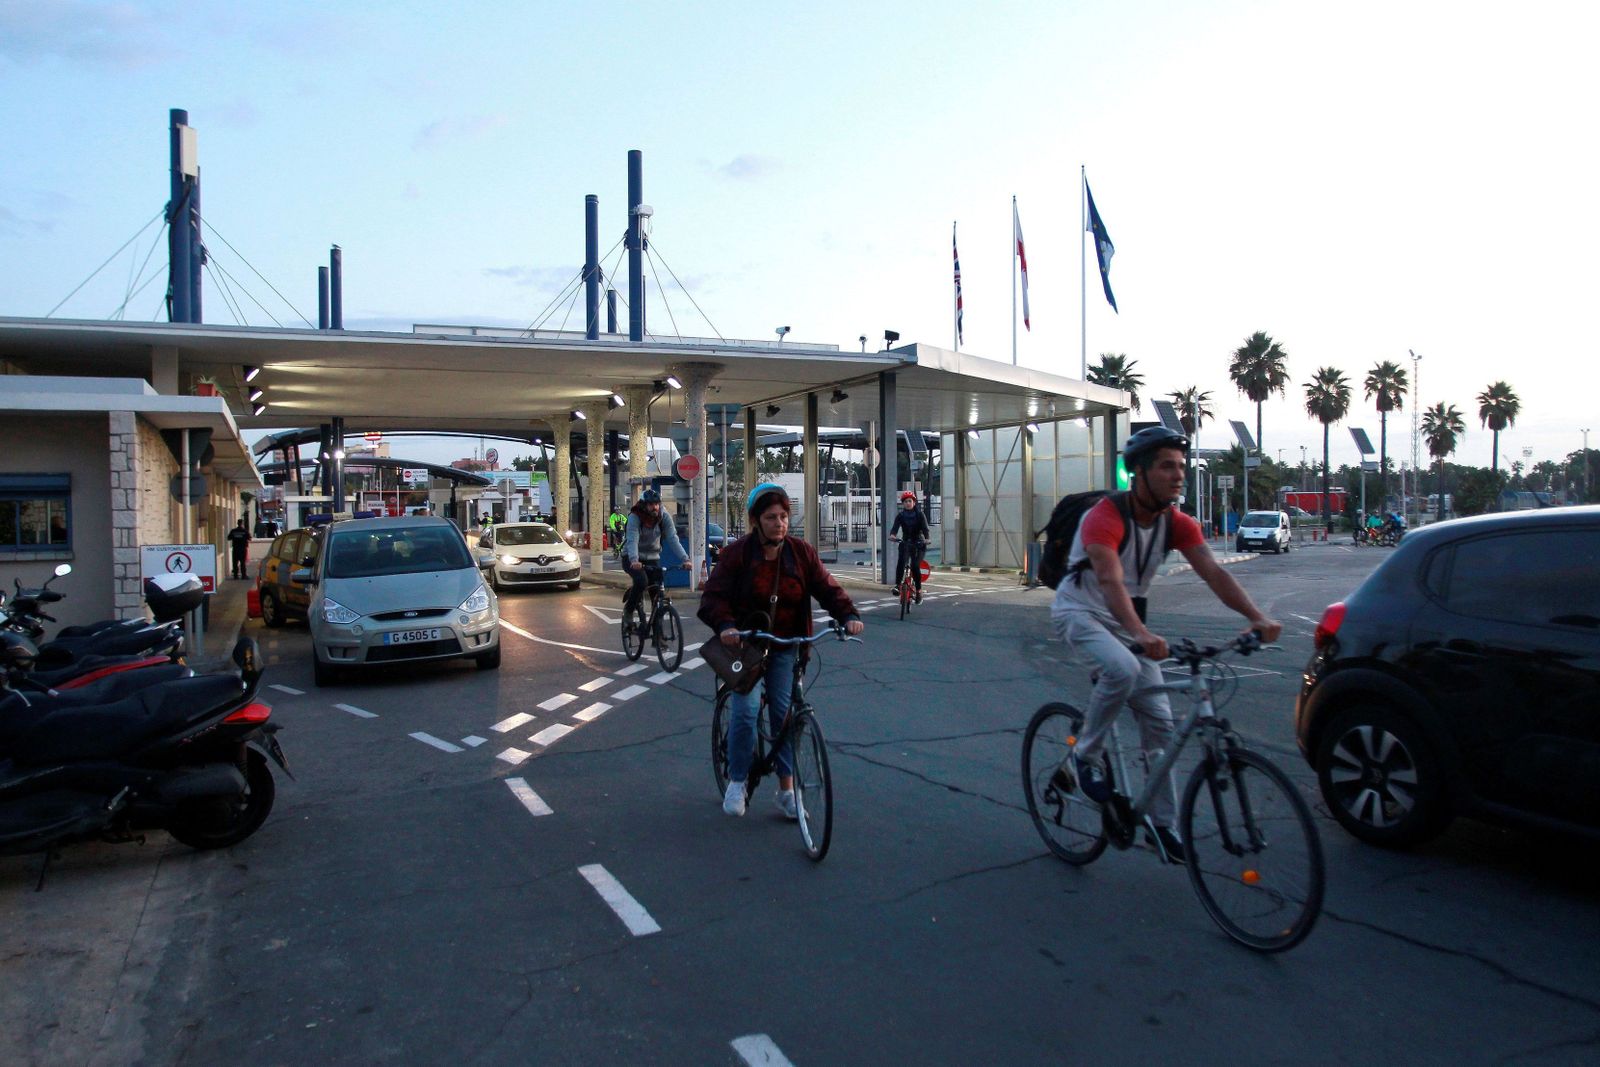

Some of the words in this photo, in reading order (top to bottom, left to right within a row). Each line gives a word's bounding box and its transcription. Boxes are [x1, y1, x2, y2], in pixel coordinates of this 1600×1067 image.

[392, 633, 400, 642] G
[402, 630, 429, 642] 4505
[431, 630, 437, 639] C
